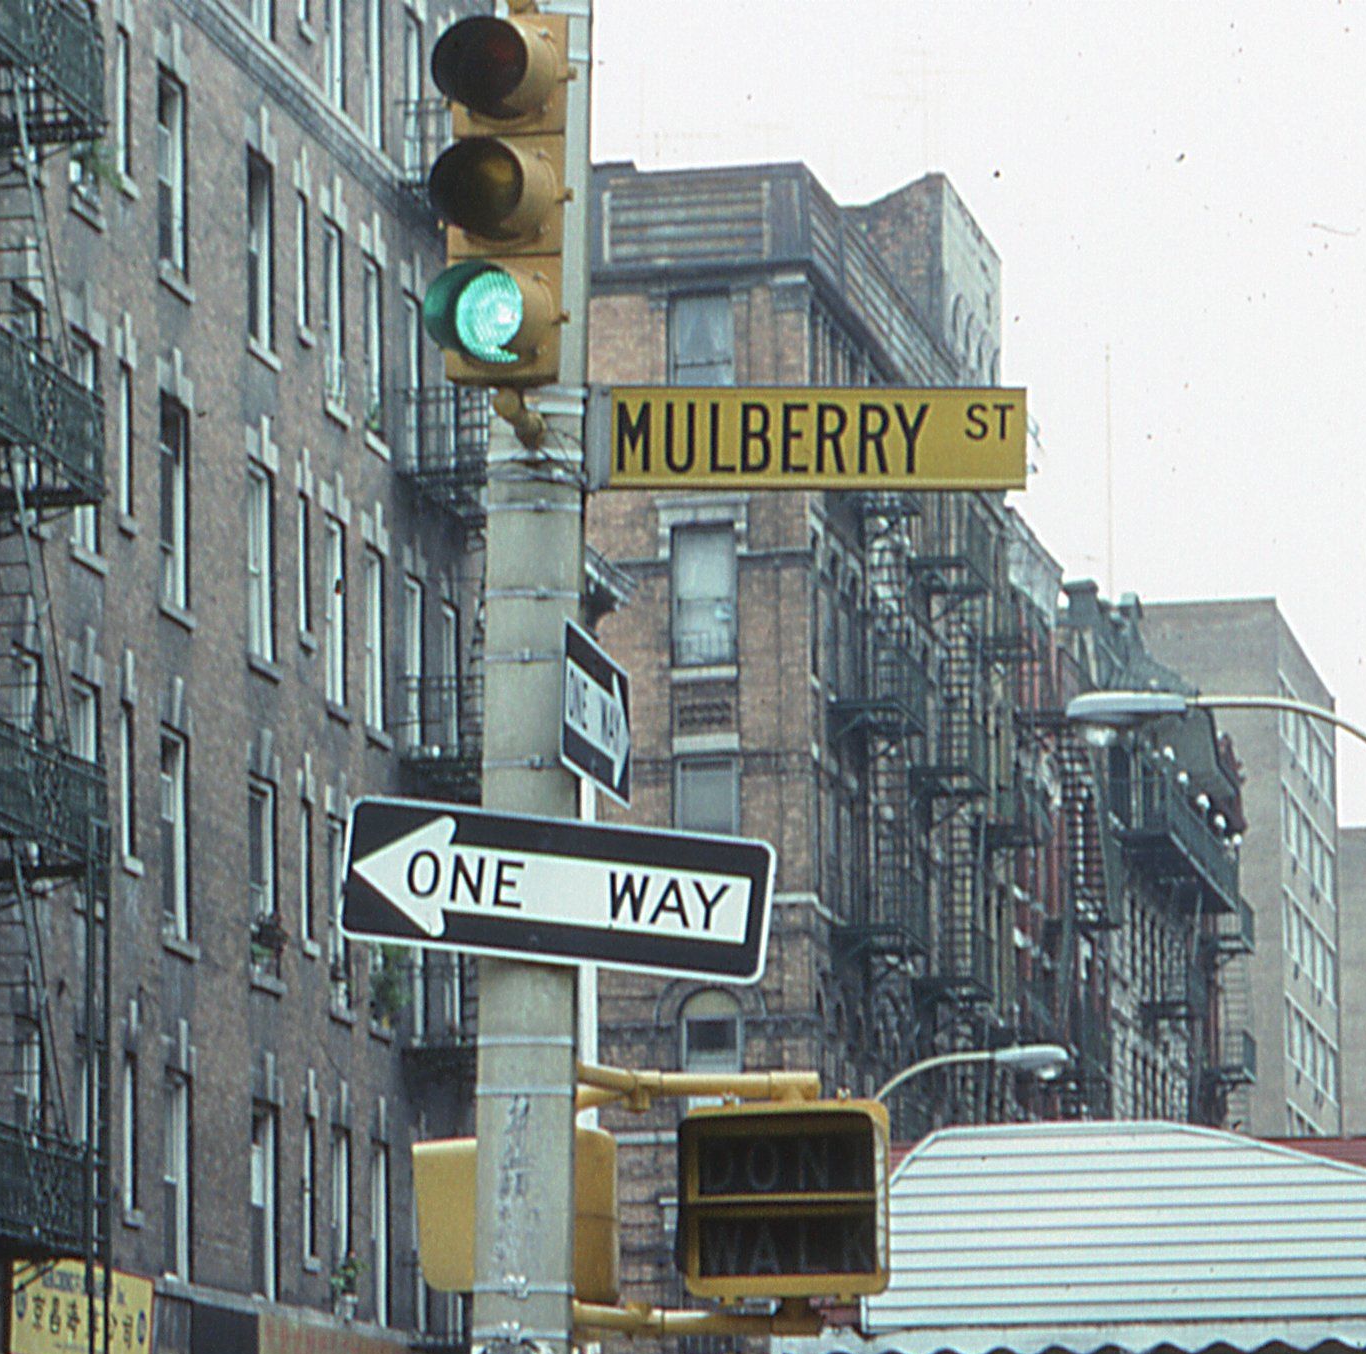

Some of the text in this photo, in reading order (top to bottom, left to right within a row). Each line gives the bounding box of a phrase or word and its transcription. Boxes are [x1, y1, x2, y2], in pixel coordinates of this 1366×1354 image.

[615, 402, 1015, 474] MULBERRY ST
[407, 850, 731, 932] ONE WAY
